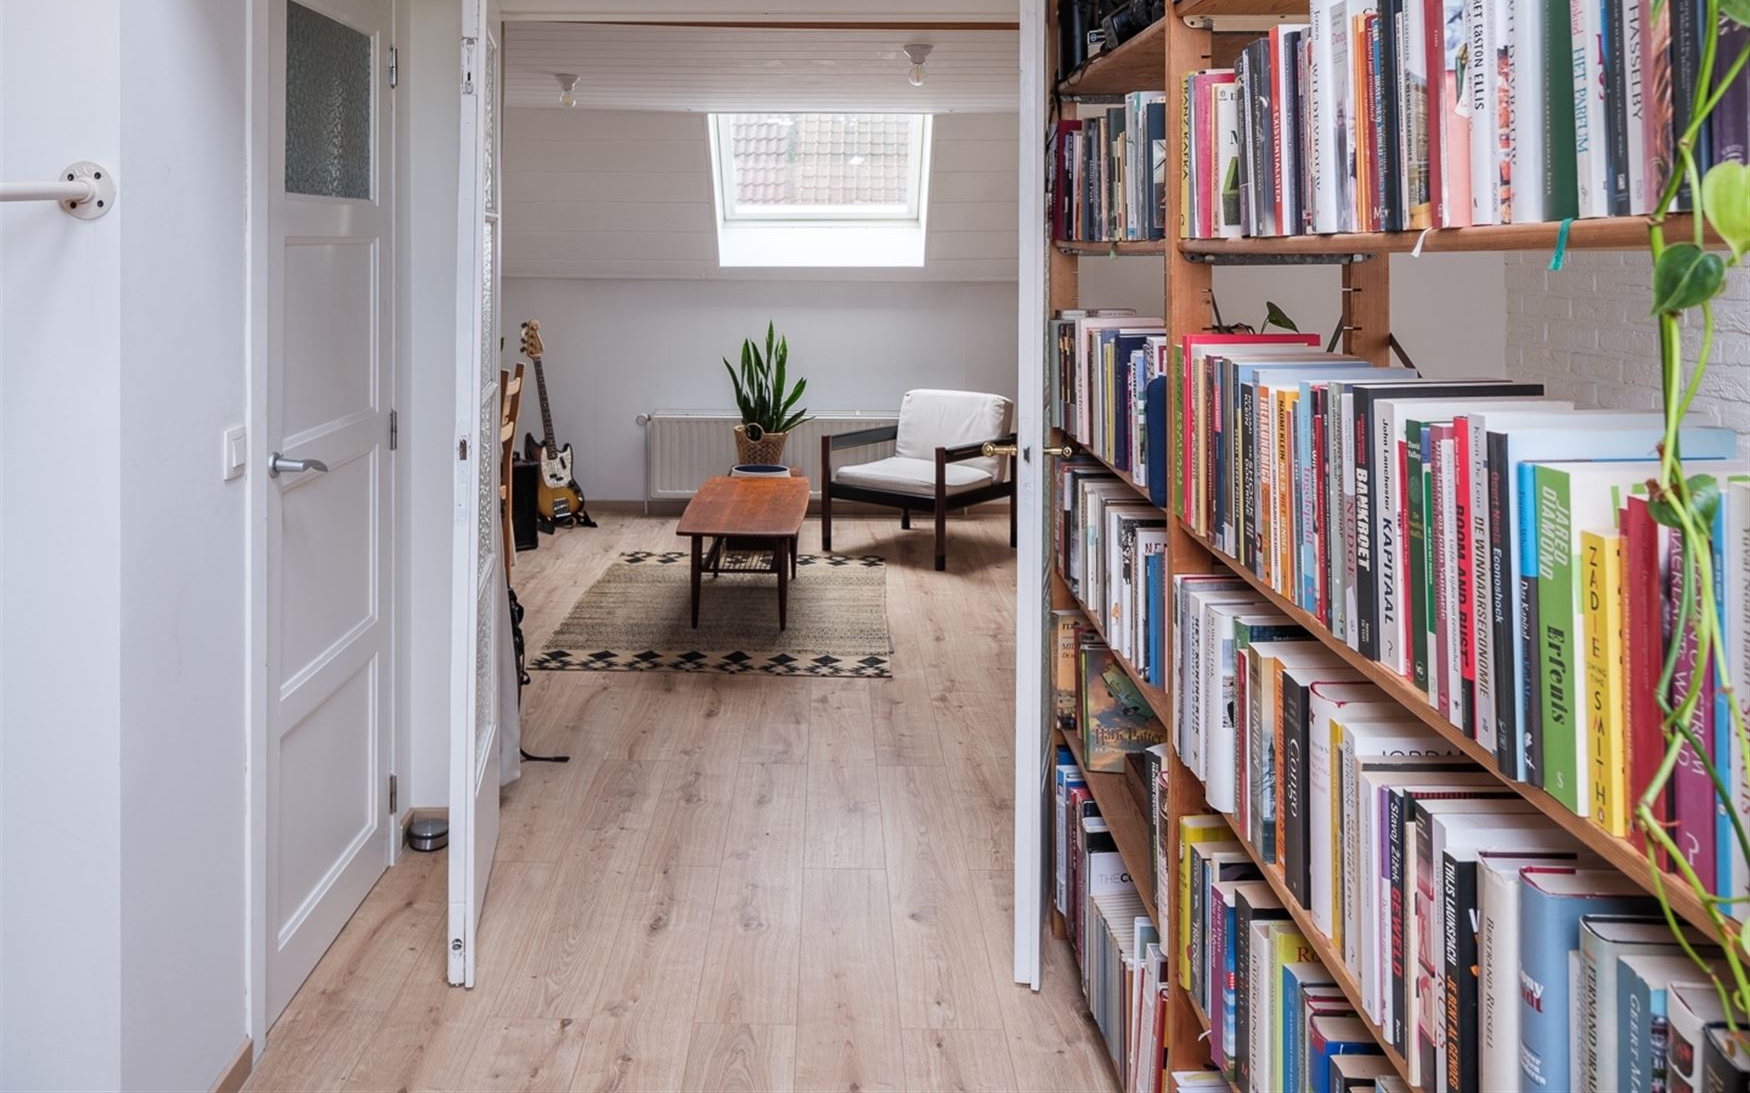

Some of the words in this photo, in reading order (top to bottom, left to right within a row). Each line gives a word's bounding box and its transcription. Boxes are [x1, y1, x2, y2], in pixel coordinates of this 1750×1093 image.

[1475, 72, 1485, 111] ELLIS
[1573, 47, 1587, 83] HET
[1629, 5, 1644, 122] HASSELBY
[1181, 78, 1190, 119] FRANZ
[1575, 87, 1589, 155] PARFUM
[1181, 133, 1190, 181] KAFKA
[1382, 418, 1390, 447] John
[1303, 466, 1313, 545] Ingelepeld
[1382, 449, 1391, 512] Lanchester
[1491, 471, 1501, 506] Geert
[1346, 499, 1355, 578] NUDGE
[1356, 466, 1370, 572] BANKROET
[1456, 504, 1465, 560] BOOM
[1474, 516, 1485, 534] DE
[1540, 485, 1557, 580] DIAMOND
[1555, 499, 1571, 566] JARED
[1383, 516, 1395, 626] KAPITAAL
[1457, 565, 1467, 605] AND
[1493, 546, 1505, 623] Econoshock
[1475, 537, 1490, 699] WINNAARSECONOMIE
[1521, 603, 1531, 640] Kapital
[1588, 546, 1602, 658] ZADIE
[1451, 617, 1459, 672] eenzaamheid
[1458, 609, 1469, 667] BUST
[1546, 624, 1568, 725] Erfenis
[1252, 700, 1260, 769] LONDEN
[1592, 691, 1607, 806] SMITH
[1287, 737, 1300, 818] Congo
[1390, 801, 1401, 844] Slavoj
[1391, 845, 1403, 883] Žižek
[1444, 861, 1456, 897] THIJS
[1392, 885, 1404, 978] GEWELD
[1445, 896, 1457, 967] LAUNSPACH
[1485, 916, 1495, 991] BERTRAND
[1447, 975, 1458, 990] JE
[1447, 992, 1459, 1025] BENT
[1588, 964, 1598, 1048] FERNAND
[1447, 1025, 1459, 1041] AL
[1485, 992, 1496, 1050] RUSSELL
[1629, 993, 1641, 1061] GEERT
[1448, 1042, 1460, 1091] GENOEG
[1630, 1061, 1642, 1093] MA
